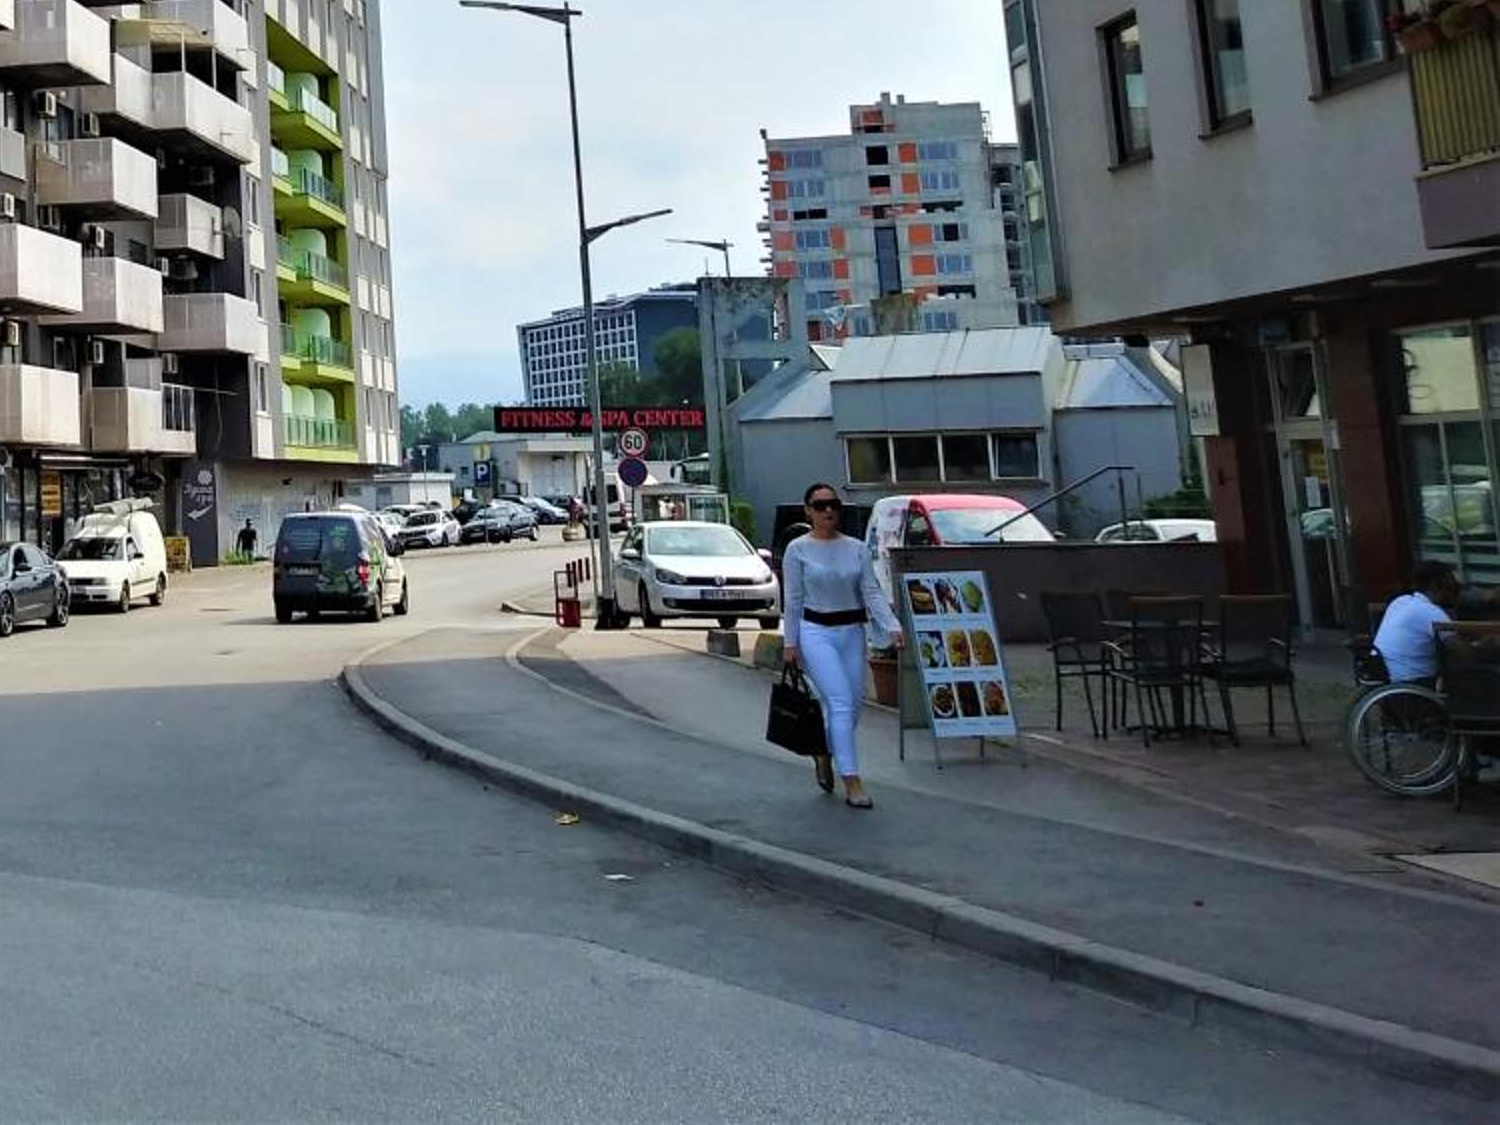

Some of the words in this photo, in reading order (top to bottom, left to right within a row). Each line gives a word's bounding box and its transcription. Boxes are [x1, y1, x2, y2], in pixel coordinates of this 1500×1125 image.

[501, 410, 575, 427] FITNESS
[633, 410, 703, 426] CENTER
[624, 435, 643, 450] 60
[477, 464, 489, 480] P
